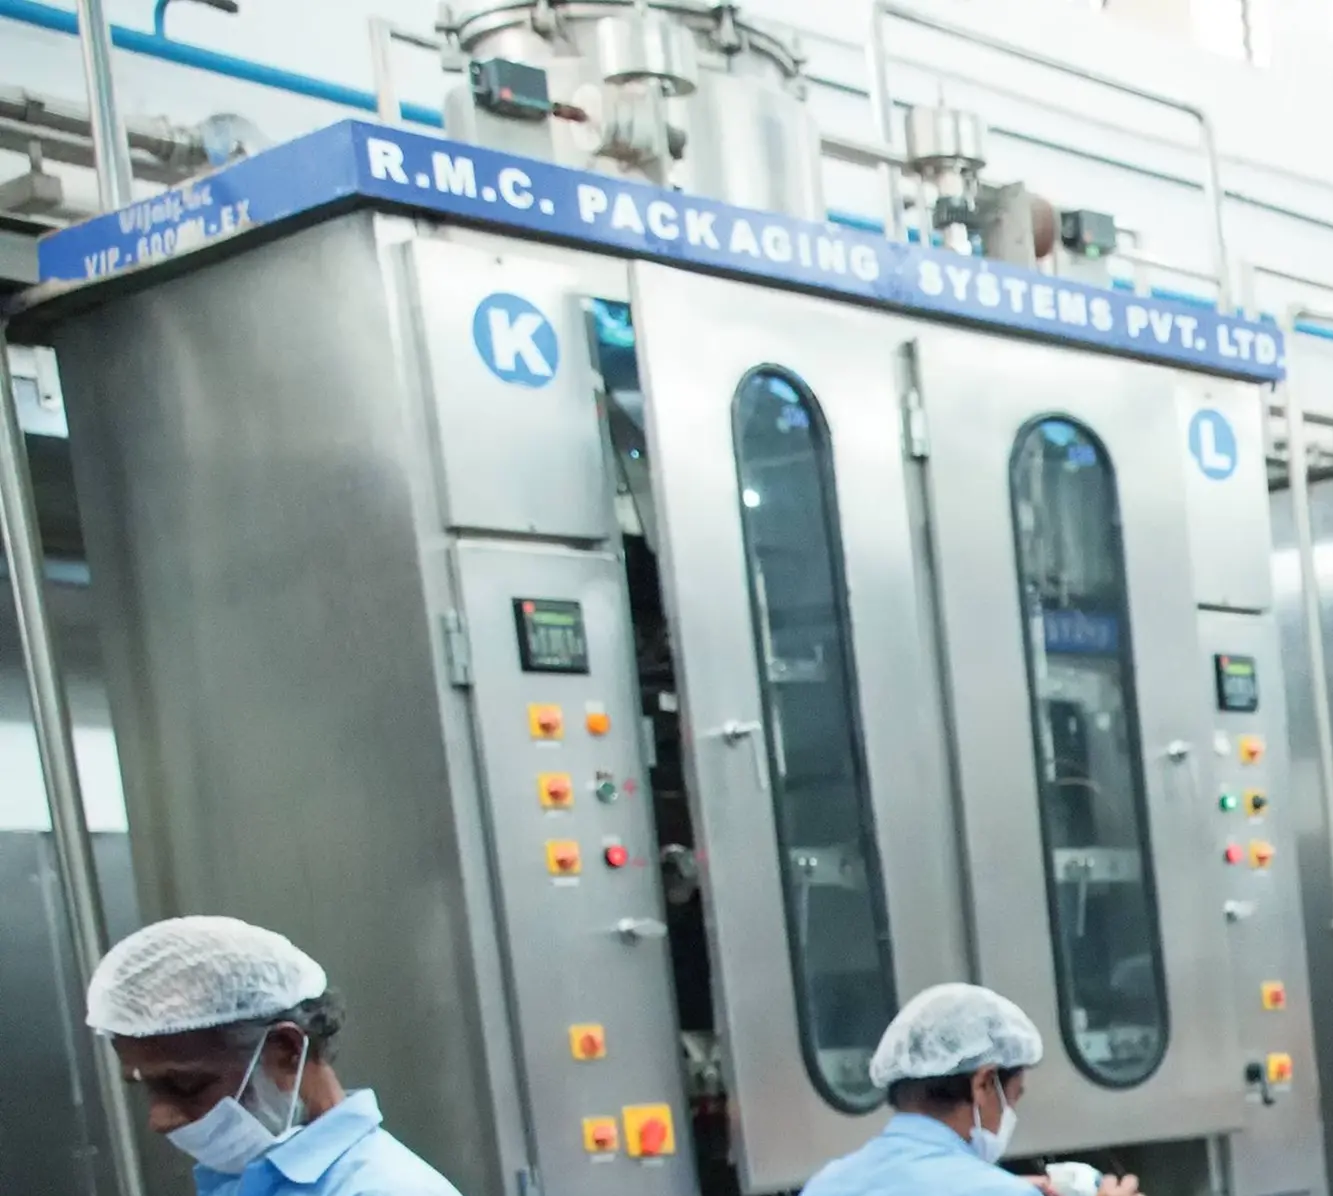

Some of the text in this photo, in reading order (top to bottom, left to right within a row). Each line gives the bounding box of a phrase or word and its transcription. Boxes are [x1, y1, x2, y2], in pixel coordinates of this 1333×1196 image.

[366, 136, 555, 215] R.M.C.
[577, 183, 880, 281] PACKAGING
[917, 258, 1114, 332] SYSTEMS
[1126, 304, 1206, 353] PVT.
[484, 306, 552, 379] K
[1197, 419, 1231, 470] L
